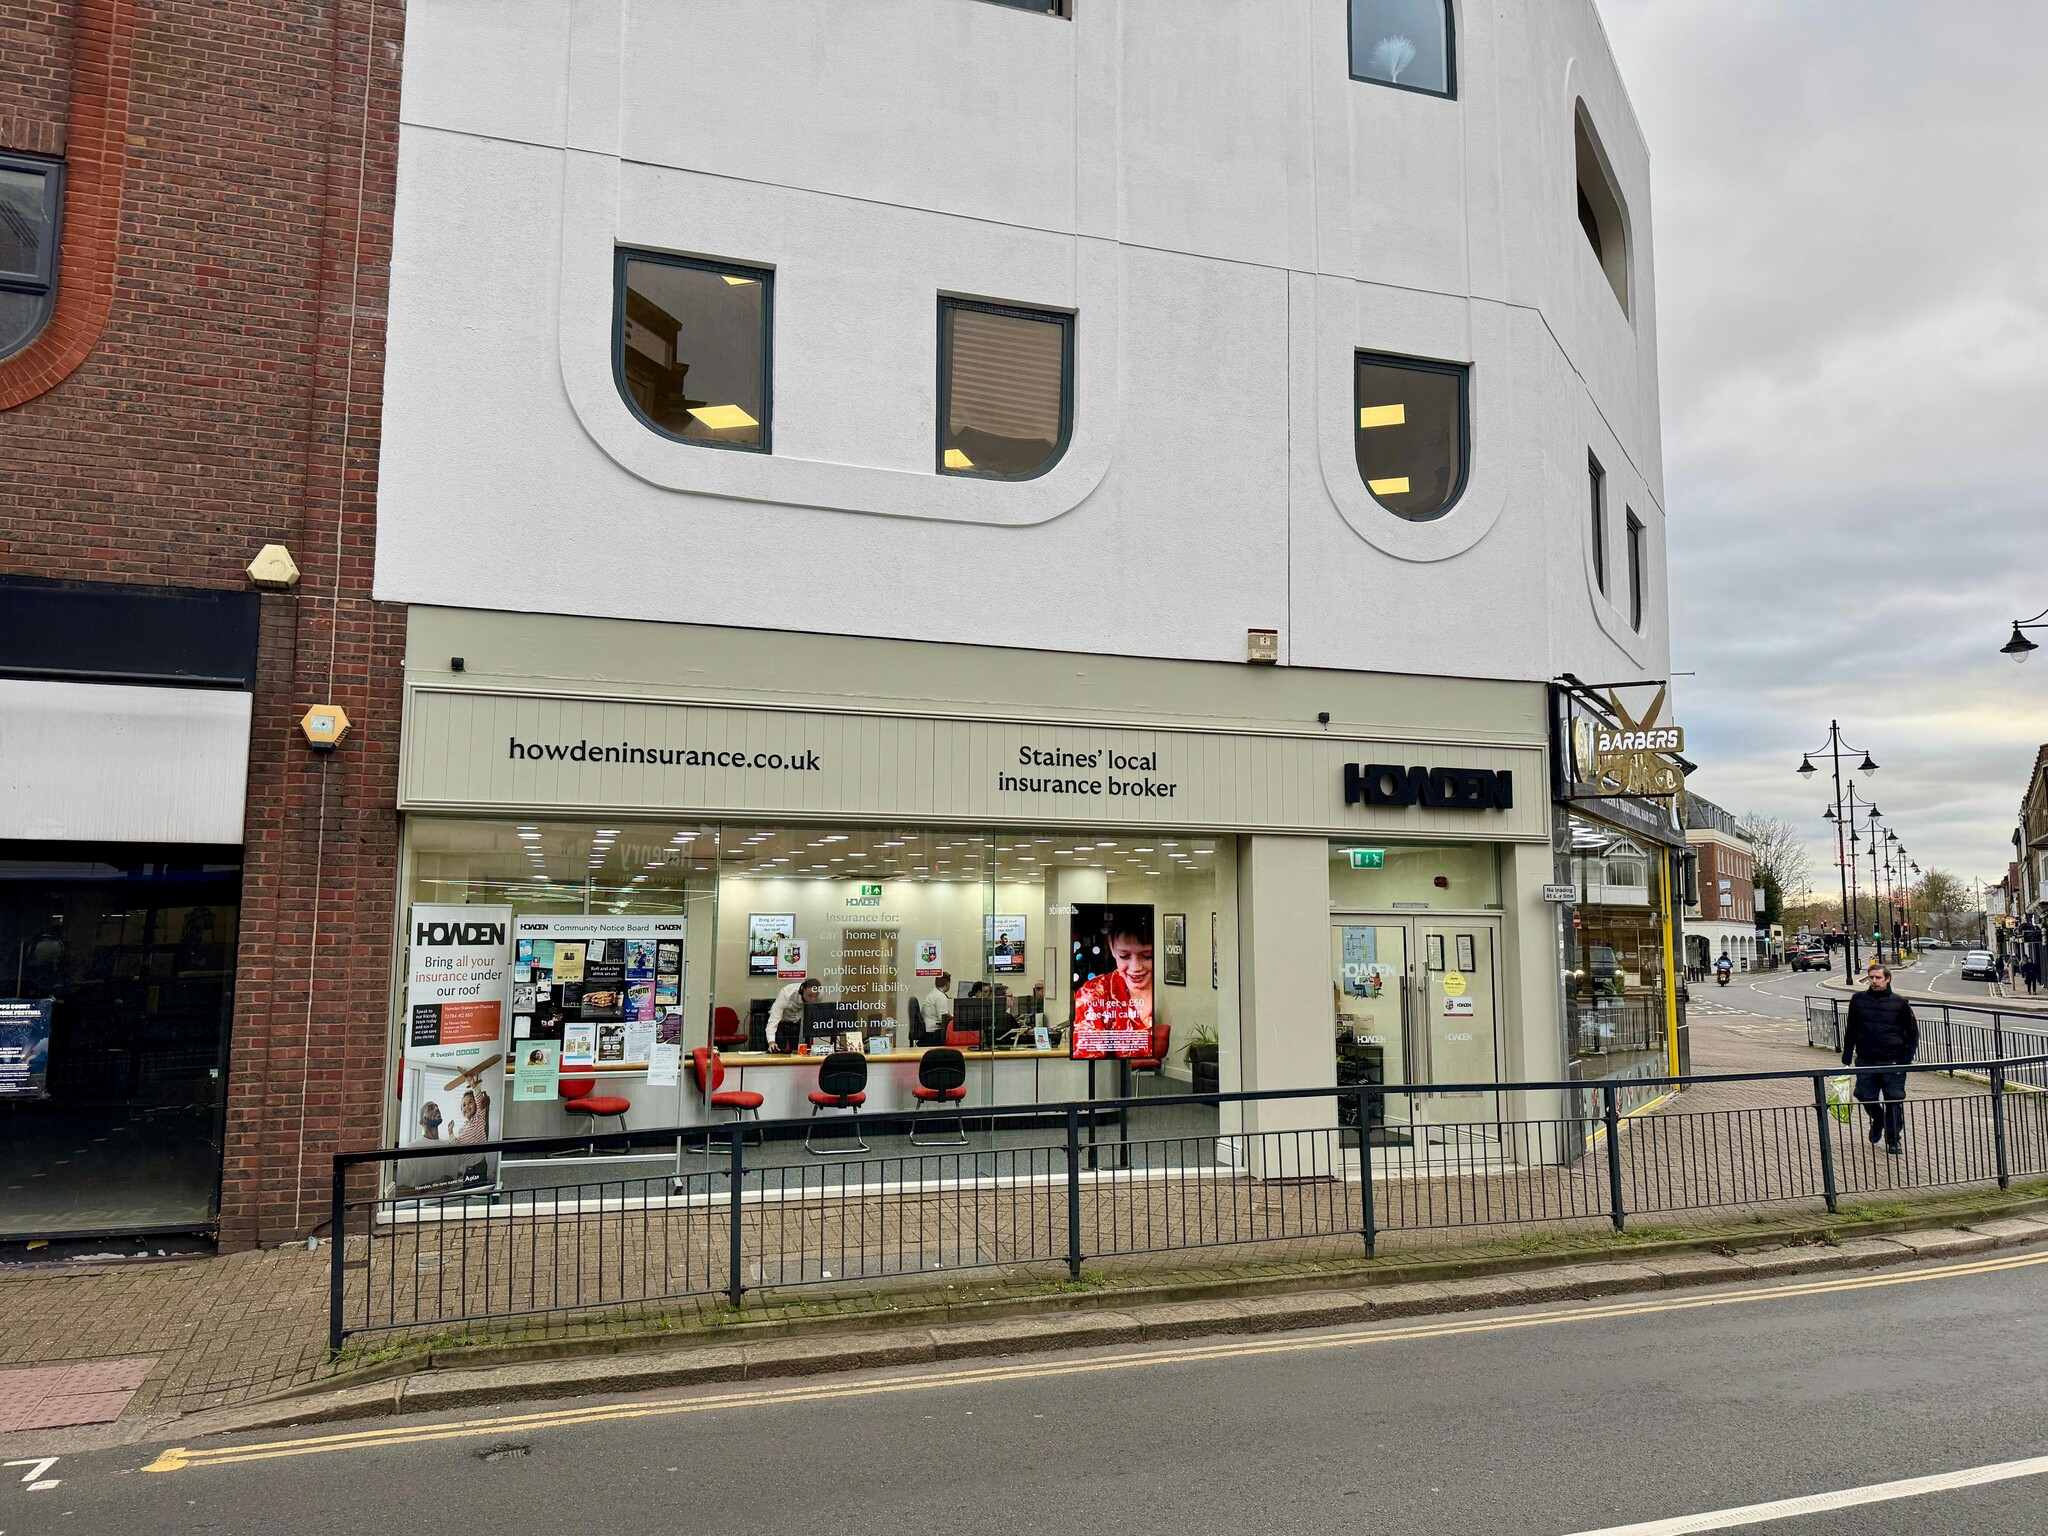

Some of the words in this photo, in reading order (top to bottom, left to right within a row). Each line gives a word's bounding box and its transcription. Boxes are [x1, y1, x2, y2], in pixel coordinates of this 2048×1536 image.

[1598, 730, 1678, 752] BARBERS
[508, 737, 820, 770] howdeninsurance.co.uk
[1108, 750, 1157, 770] local
[998, 772, 1102, 795] insurance
[1108, 776, 1177, 797] broker
[1344, 762, 1514, 809] HOWDEN
[846, 898, 880, 906] HOWDEN
[826, 912, 878, 922] Insurance
[881, 912, 899, 922] for:
[554, 924, 597, 932] Community
[416, 922, 505, 946] HOWDEN
[846, 930, 876, 939] home
[830, 947, 893, 957] commercial
[425, 956, 453, 969] Bring
[456, 956, 468, 967] all
[471, 958, 495, 968] your
[824, 965, 857, 976] public
[860, 965, 900, 976] liability
[1338, 963, 1397, 977] HOWDEN
[415, 971, 468, 983] insurance
[471, 969, 502, 981] under
[437, 987, 455, 996] our
[458, 983, 480, 995] roof
[872, 982, 910, 993] liability
[836, 1000, 886, 1010] landlords
[1106, 1000, 1119, 1008] get
[1084, 1010, 1116, 1018] One4all
[812, 1018, 833, 1029] and
[837, 1018, 867, 1028] much
